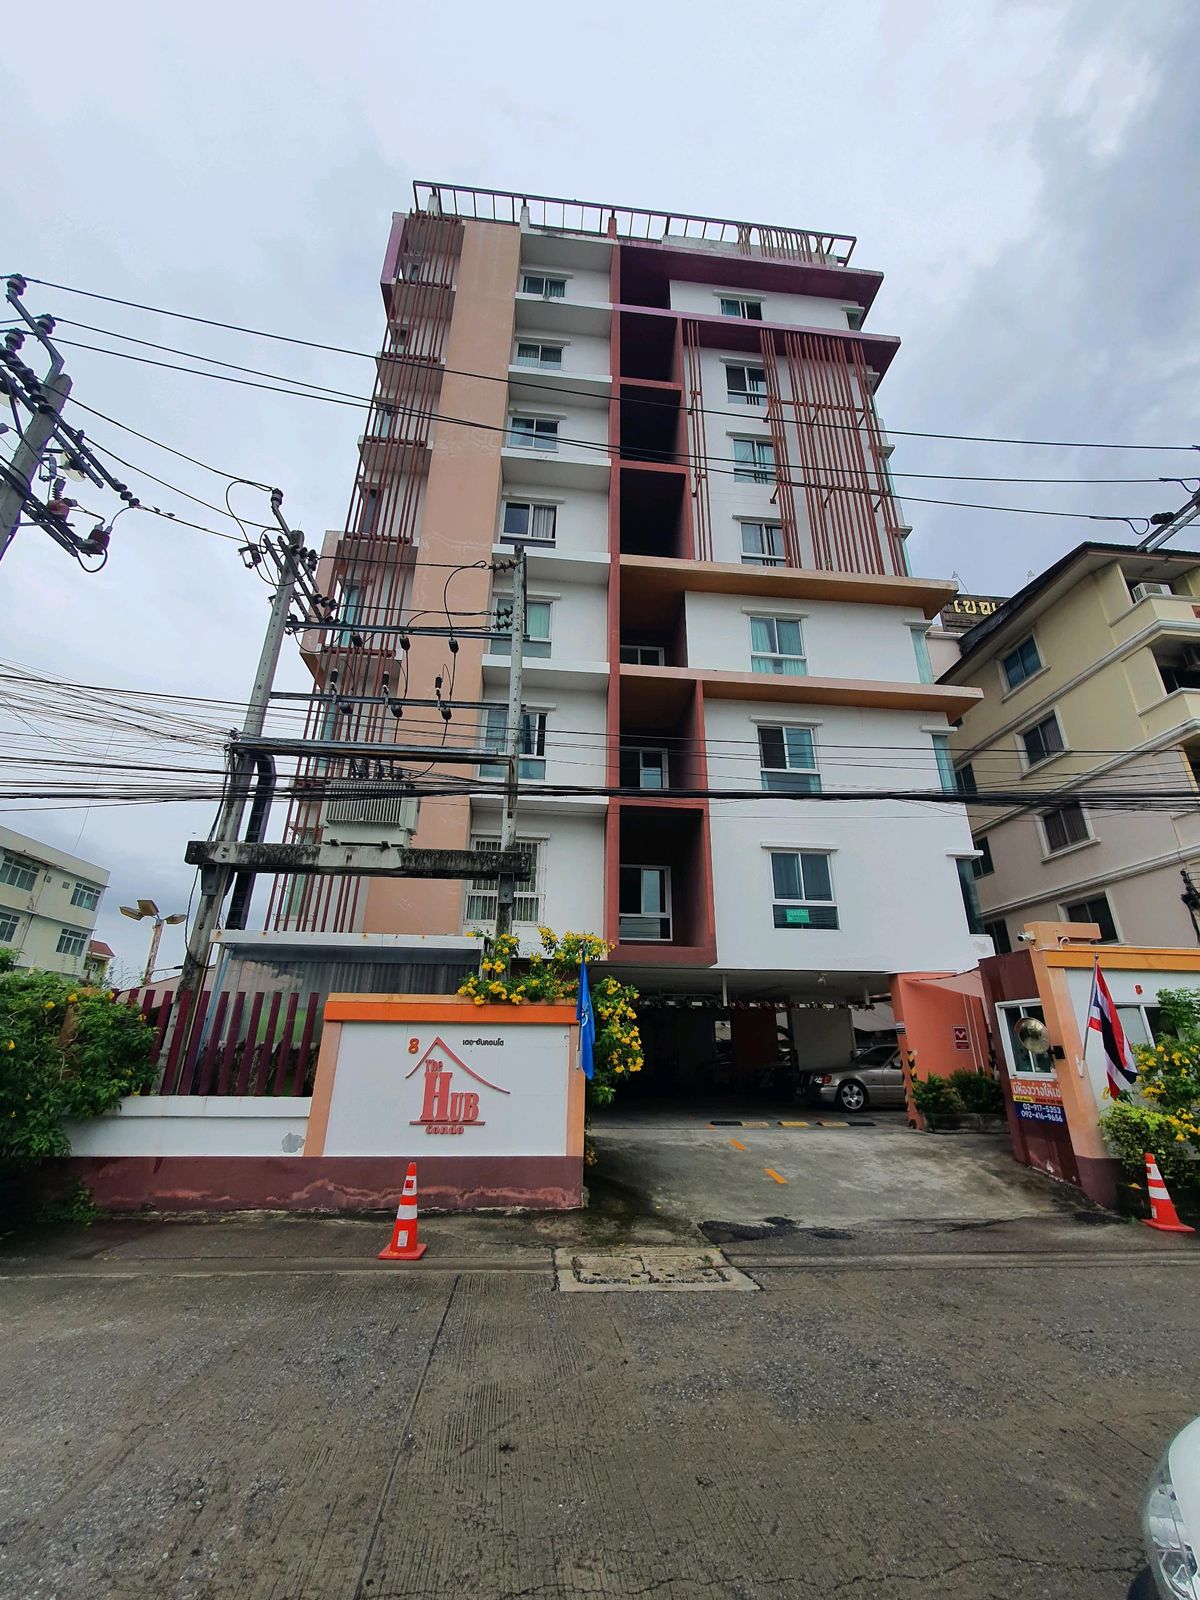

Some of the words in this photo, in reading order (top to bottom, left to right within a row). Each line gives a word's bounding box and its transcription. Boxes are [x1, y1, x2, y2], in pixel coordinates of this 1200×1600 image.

[408, 1038, 420, 1054] 8
[425, 1059, 443, 1072] The
[420, 1071, 480, 1122] HUB
[425, 1125, 465, 1135] Condo
